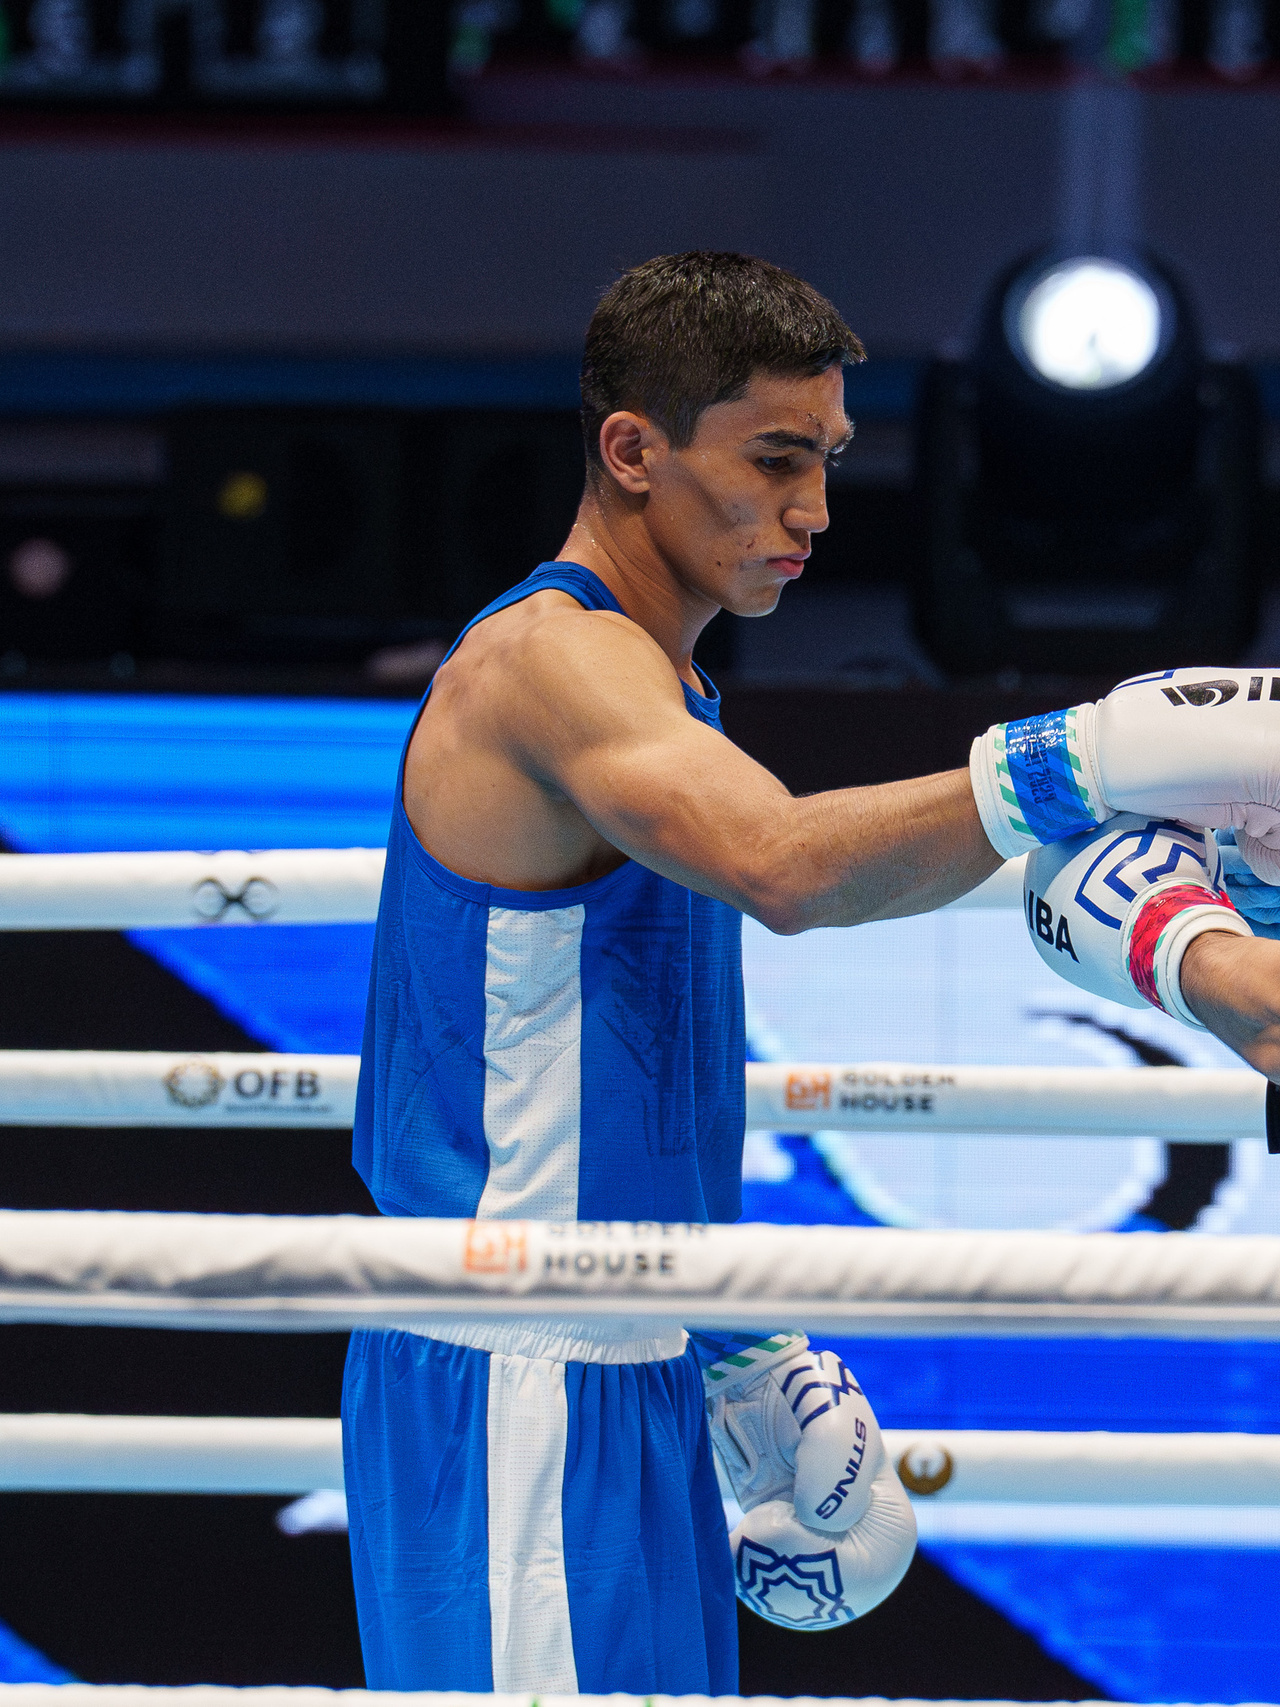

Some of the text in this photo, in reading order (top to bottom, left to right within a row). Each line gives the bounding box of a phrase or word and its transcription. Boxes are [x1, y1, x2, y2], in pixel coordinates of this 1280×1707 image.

[1028, 889, 1081, 964] IBA
[234, 1068, 320, 1100] OFB
[840, 1092, 934, 1113] HOUSE
[545, 1252, 675, 1275] HOUSE
[815, 1416, 868, 1520] STING
